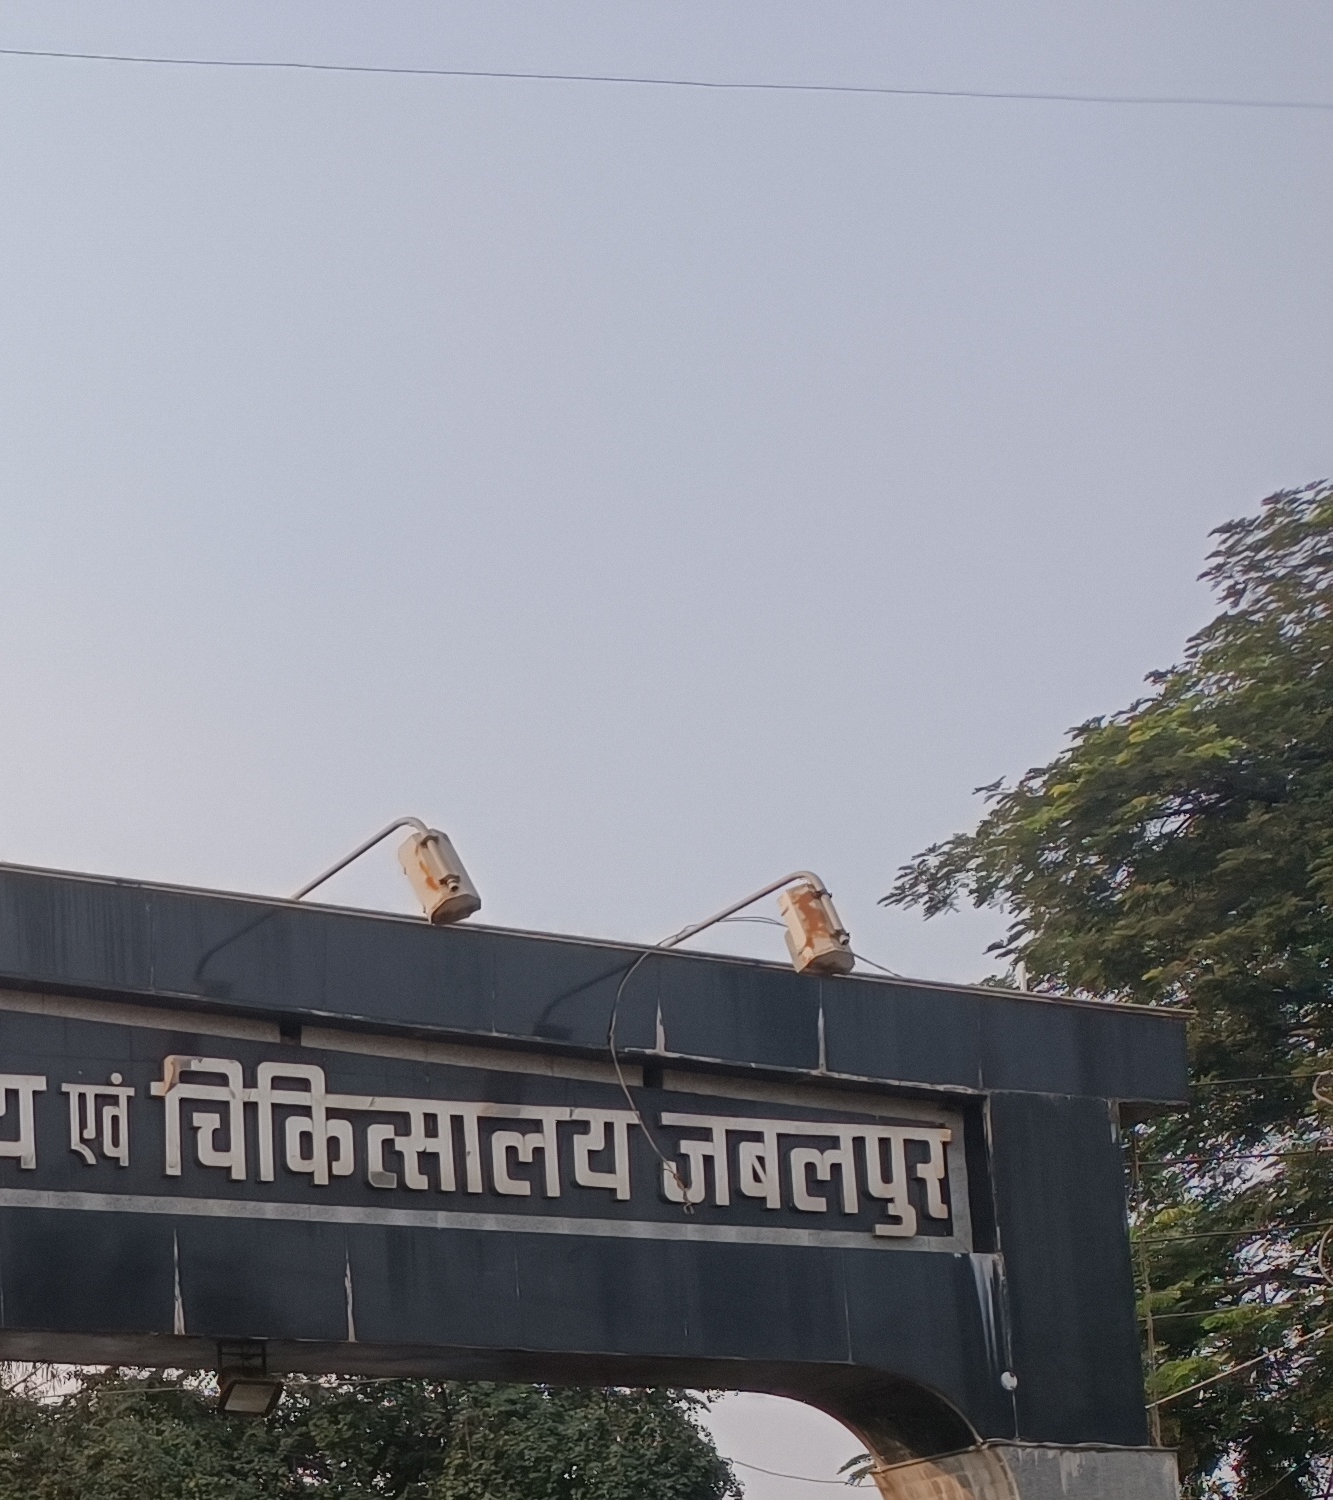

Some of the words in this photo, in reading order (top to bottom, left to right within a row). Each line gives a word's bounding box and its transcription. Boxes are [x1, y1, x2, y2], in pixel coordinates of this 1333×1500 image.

[61, 1072, 136, 1167] एवं
[150, 1055, 641, 1201] चिकित्सालय
[659, 1111, 952, 1239] जबलपुर
